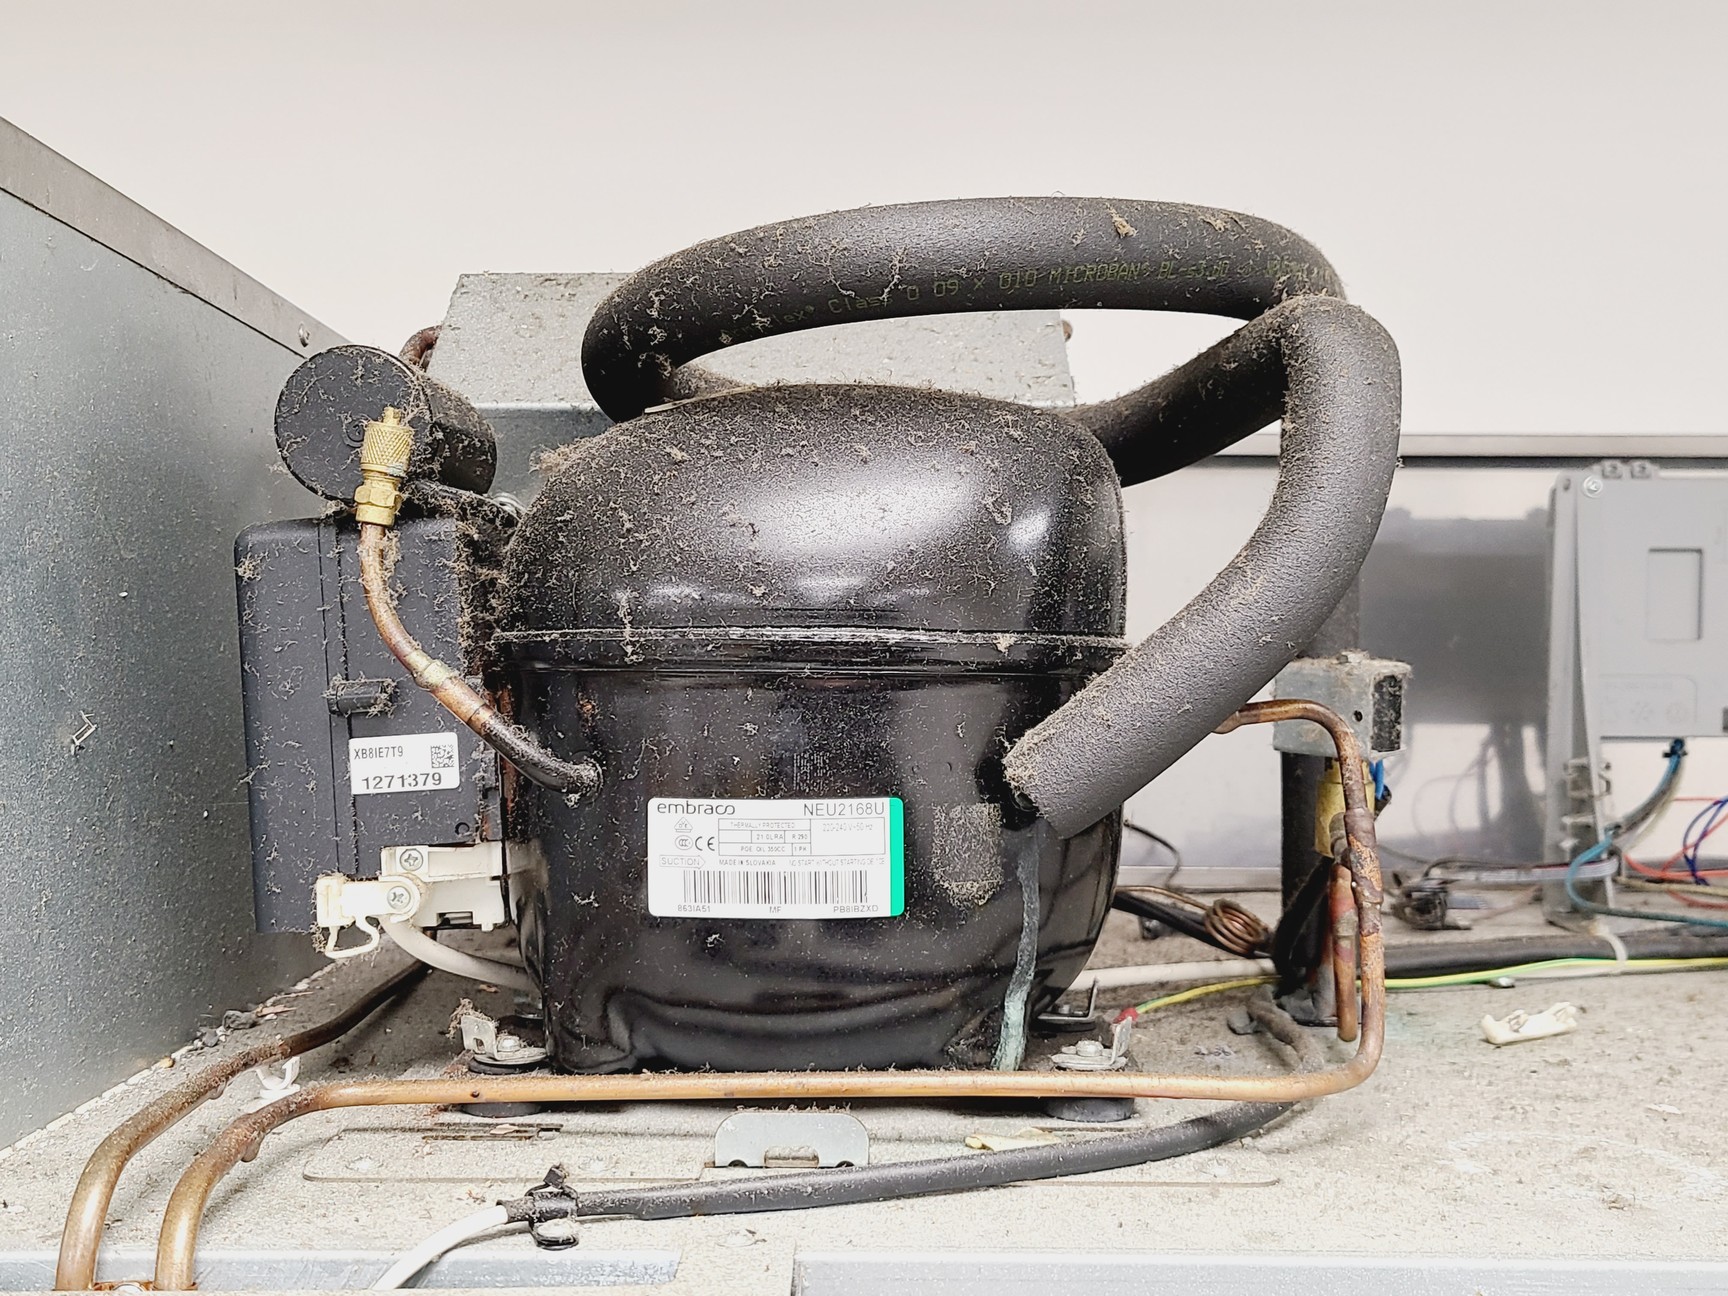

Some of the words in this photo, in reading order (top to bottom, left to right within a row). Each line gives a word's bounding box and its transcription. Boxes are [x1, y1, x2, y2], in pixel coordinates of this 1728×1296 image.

[934, 279, 959, 297] 09
[362, 772, 442, 790] 1271379
[657, 801, 736, 815] embraco
[803, 801, 885, 817] NEU2168U
[762, 821, 795, 829] PROTECTED
[661, 856, 701, 866] SUCTION
